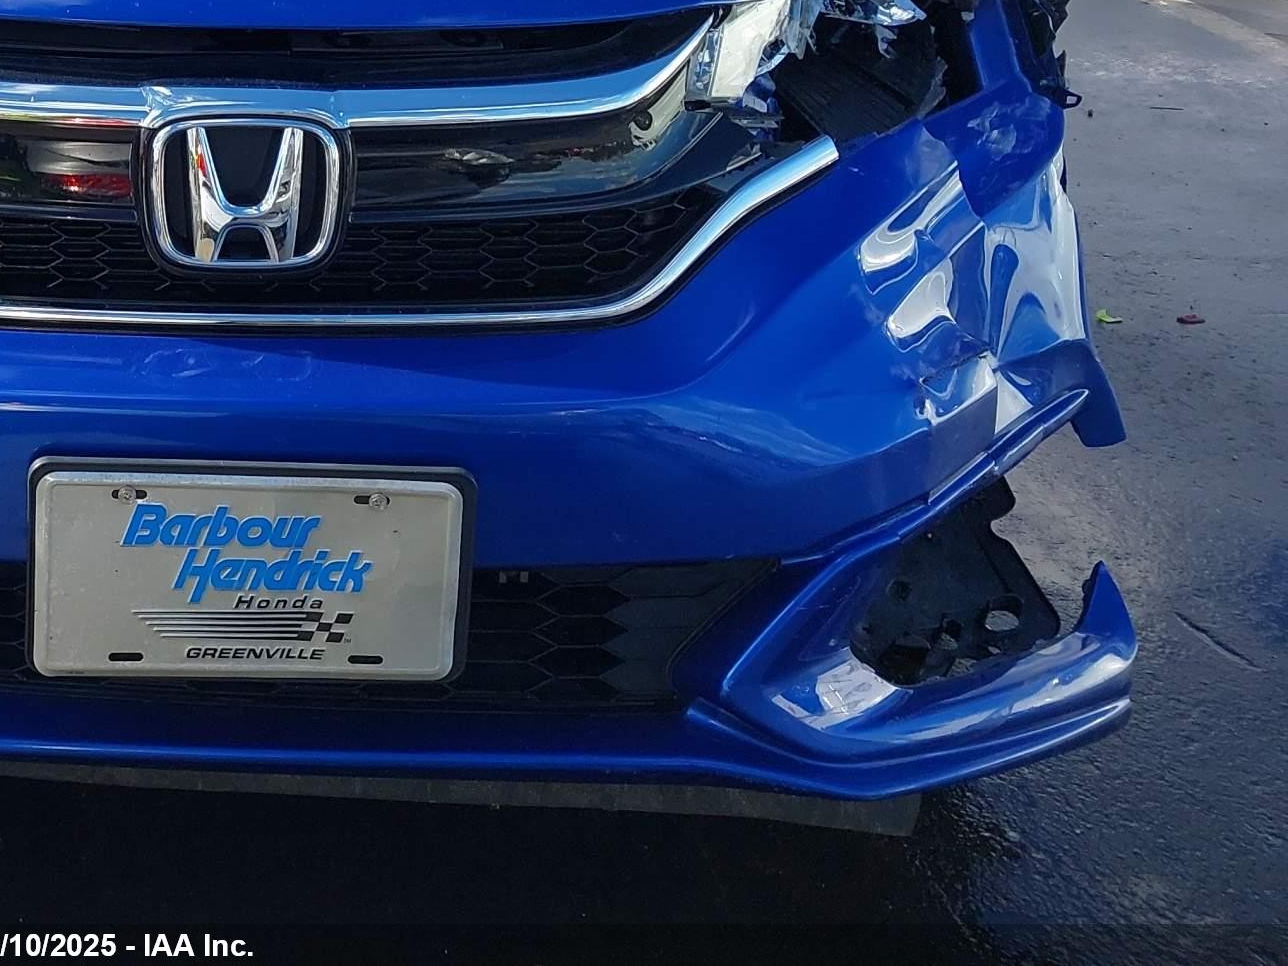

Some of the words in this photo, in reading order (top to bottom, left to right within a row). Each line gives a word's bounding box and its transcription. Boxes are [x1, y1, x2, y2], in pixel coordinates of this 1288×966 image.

[120, 502, 323, 547] Barbour
[172, 548, 374, 604] Hendrick
[234, 595, 323, 610] Honda
[186, 646, 325, 661] GREENVILLE
